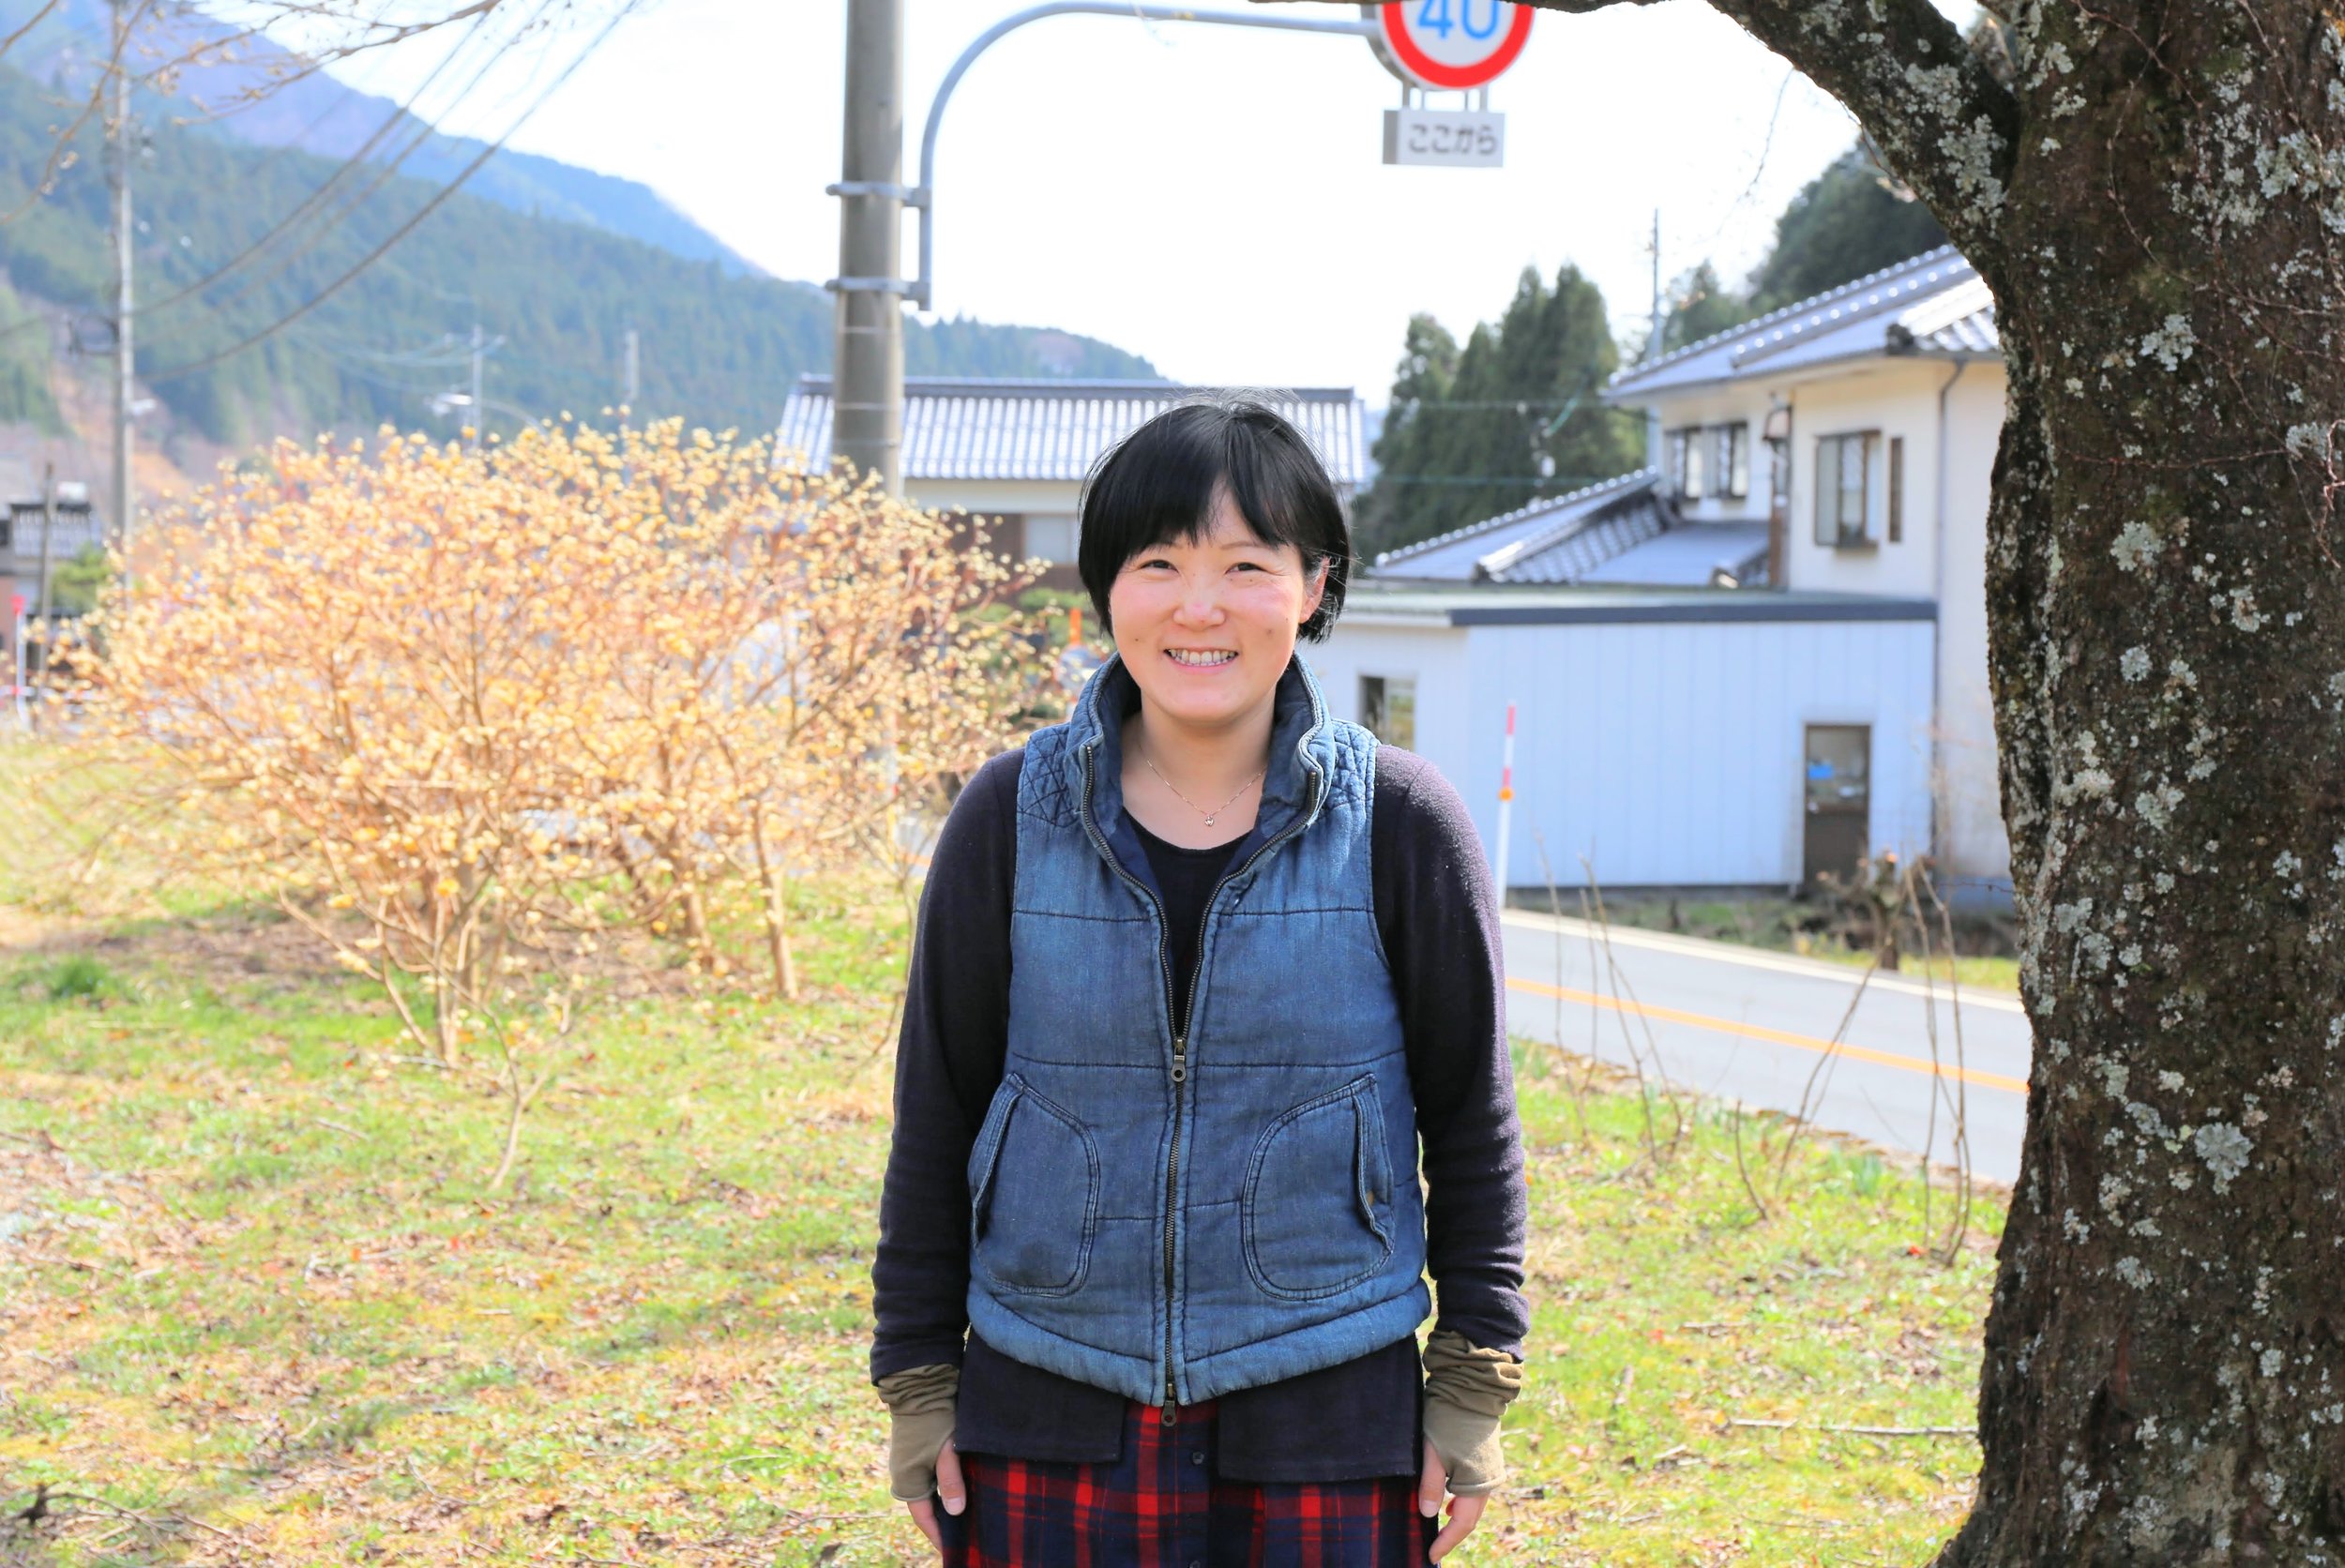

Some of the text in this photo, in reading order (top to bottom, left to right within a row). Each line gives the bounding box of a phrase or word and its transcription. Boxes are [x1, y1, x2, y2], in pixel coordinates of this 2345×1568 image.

[1417, 0, 1501, 39] 40
[1409, 124, 1498, 156] ここから
